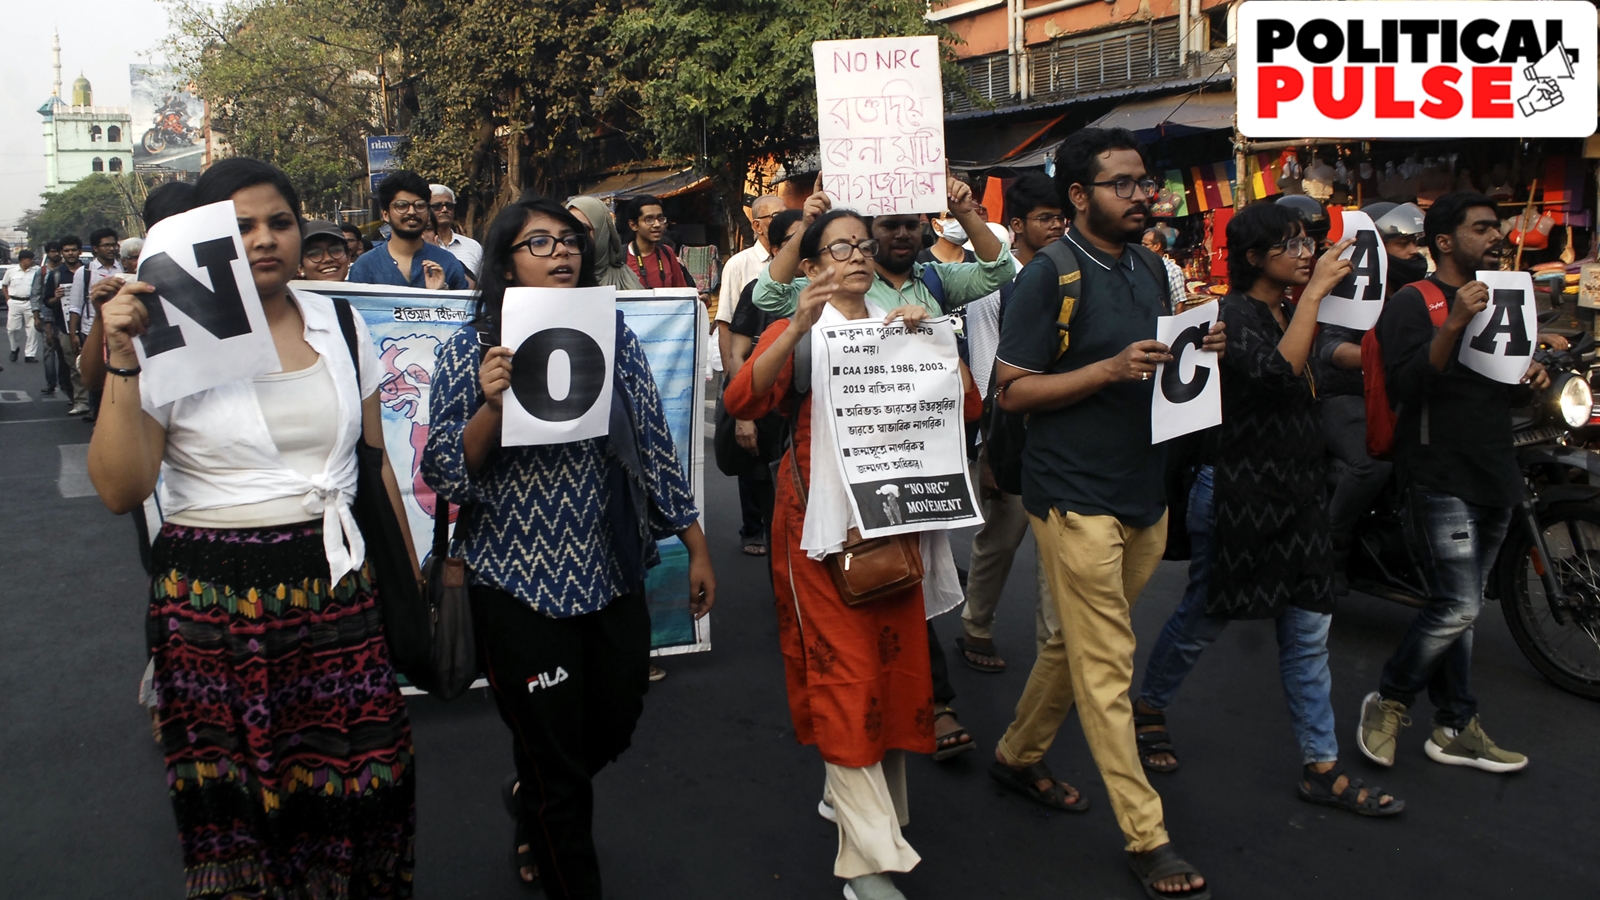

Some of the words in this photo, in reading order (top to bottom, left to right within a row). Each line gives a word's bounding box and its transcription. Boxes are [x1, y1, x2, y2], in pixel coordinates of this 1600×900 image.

[834, 51, 868, 73] NO
[876, 49, 920, 70] NRC
[890, 127, 941, 166] মাটি
[1330, 229, 1383, 301] A
[137, 236, 252, 358] N
[838, 329, 864, 340] নতুন
[866, 328, 875, 336] বা
[1469, 288, 1532, 356] A
[843, 345, 860, 353] CAA
[862, 345, 879, 355] নয়।
[1161, 320, 1211, 404] C
[510, 327, 606, 422] O
[843, 366, 861, 375] CAA
[863, 365, 888, 374] 1985,
[891, 364, 917, 373] 1986,
[919, 362, 947, 371] 2003,
[843, 385, 866, 394] 2019
[868, 381, 895, 394] বাতিল
[897, 383, 915, 393] কর।
[884, 403, 917, 415] ভারতের
[848, 425, 874, 436] ভারতে
[913, 416, 946, 430] নাগরিক।
[906, 498, 962, 514] MOVEMENT
[526, 666, 569, 693] FILA
